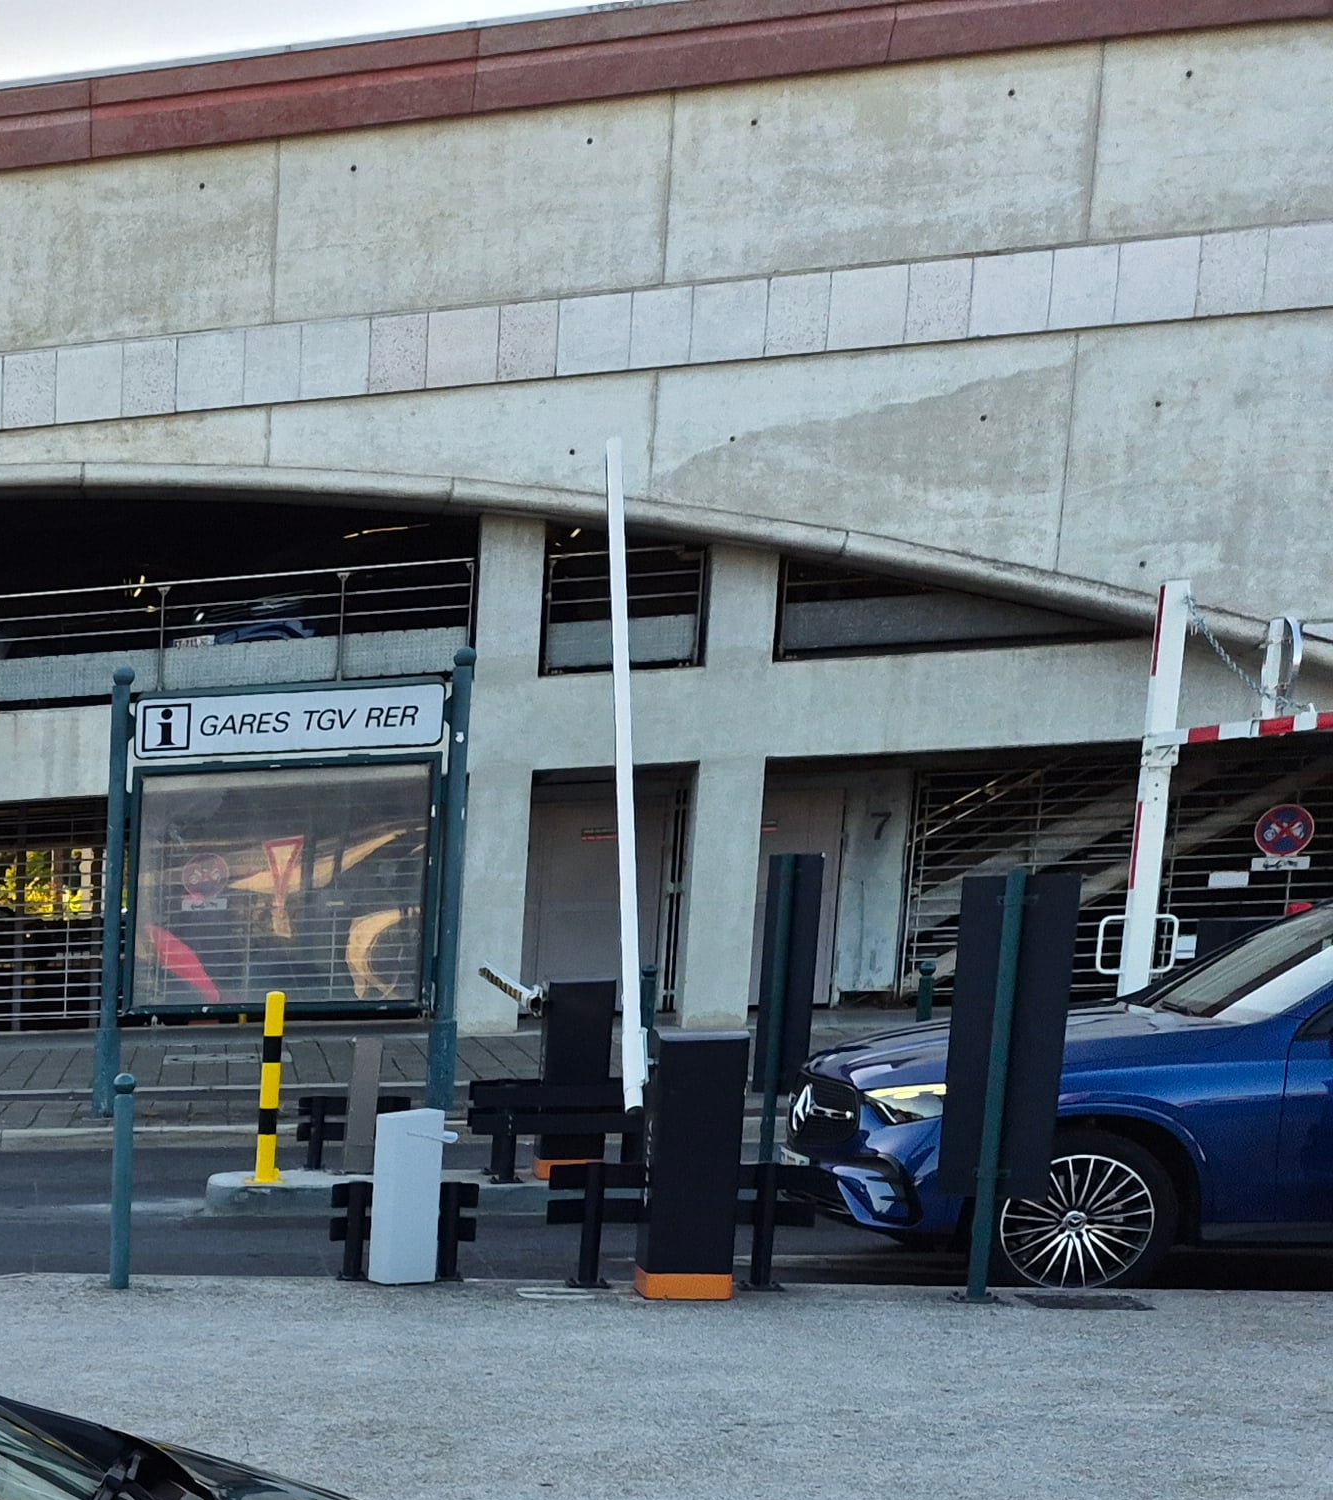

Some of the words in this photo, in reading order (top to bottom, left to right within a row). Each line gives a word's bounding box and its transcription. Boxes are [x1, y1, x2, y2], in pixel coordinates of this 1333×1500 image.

[199, 710, 291, 737] GARES
[303, 707, 357, 731] TGV
[364, 705, 420, 729] RER
[870, 810, 893, 841] 7
